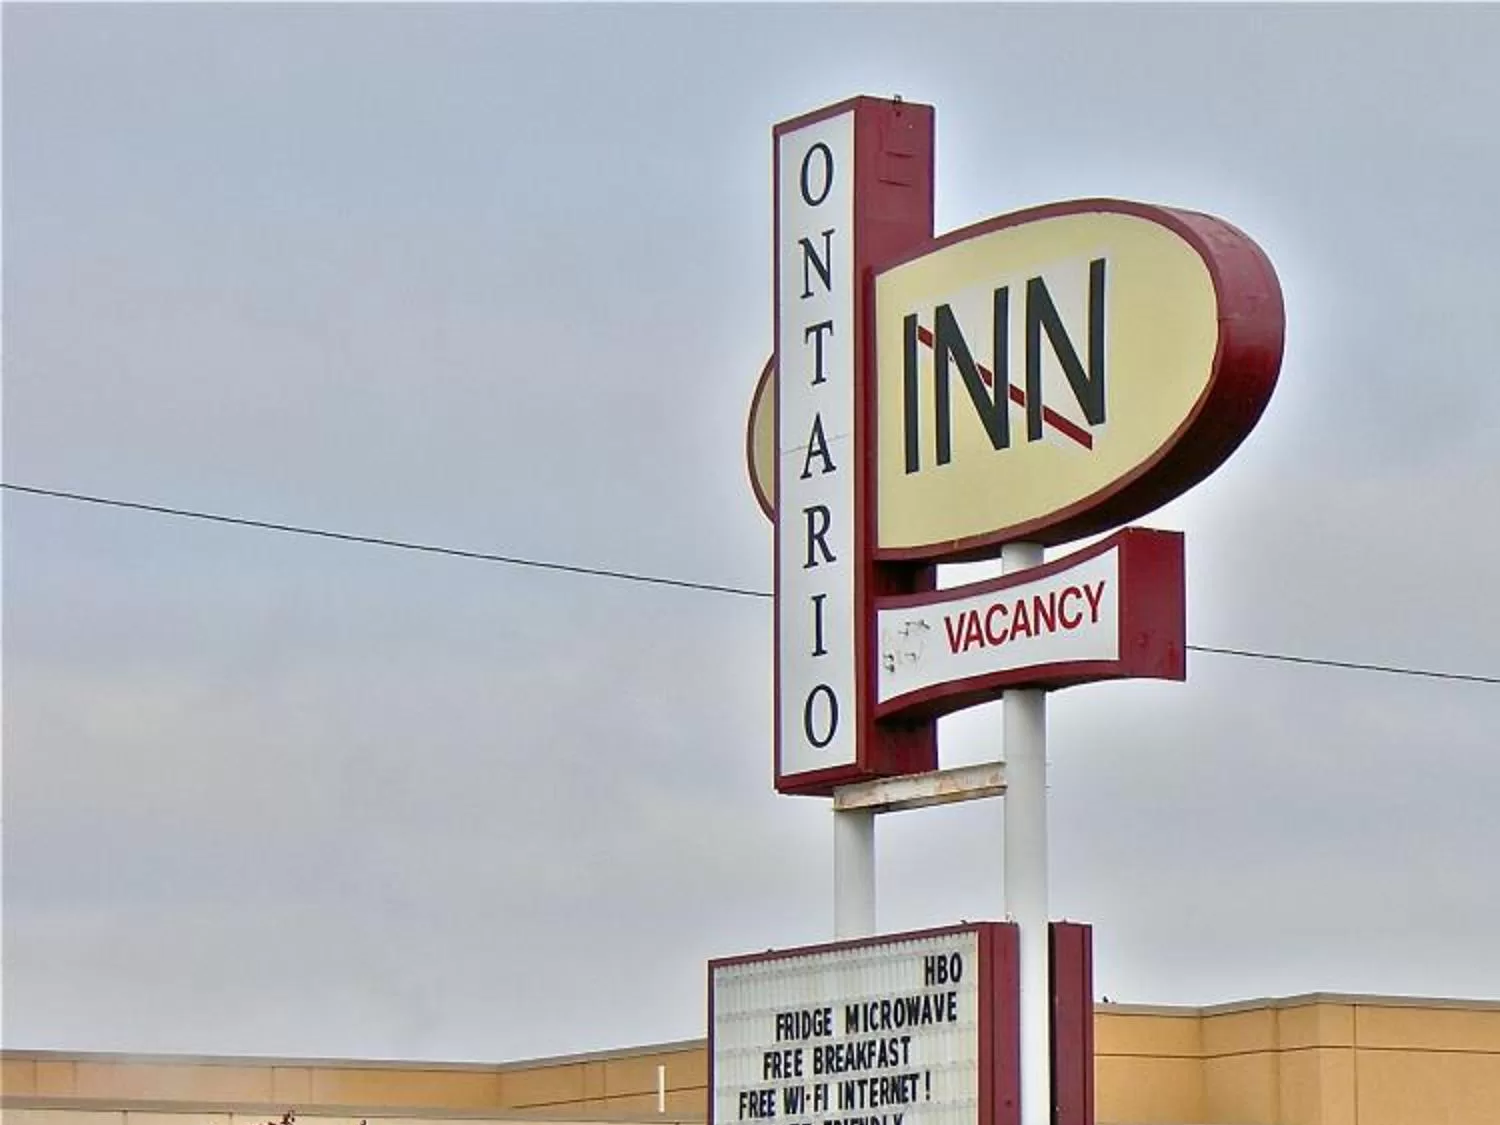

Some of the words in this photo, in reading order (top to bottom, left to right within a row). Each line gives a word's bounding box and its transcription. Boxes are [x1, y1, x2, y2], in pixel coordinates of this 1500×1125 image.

[902, 257, 1107, 475] INN
[798, 141, 839, 750] ONTARIO
[944, 580, 1105, 654] VACANCY
[924, 952, 962, 986] HBO
[776, 1007, 832, 1042] FRIDGE
[845, 991, 957, 1034] MICROWAVE
[763, 1049, 803, 1080] FREE
[813, 1035, 911, 1075] BREAKFAST
[739, 1089, 776, 1120] FREE
